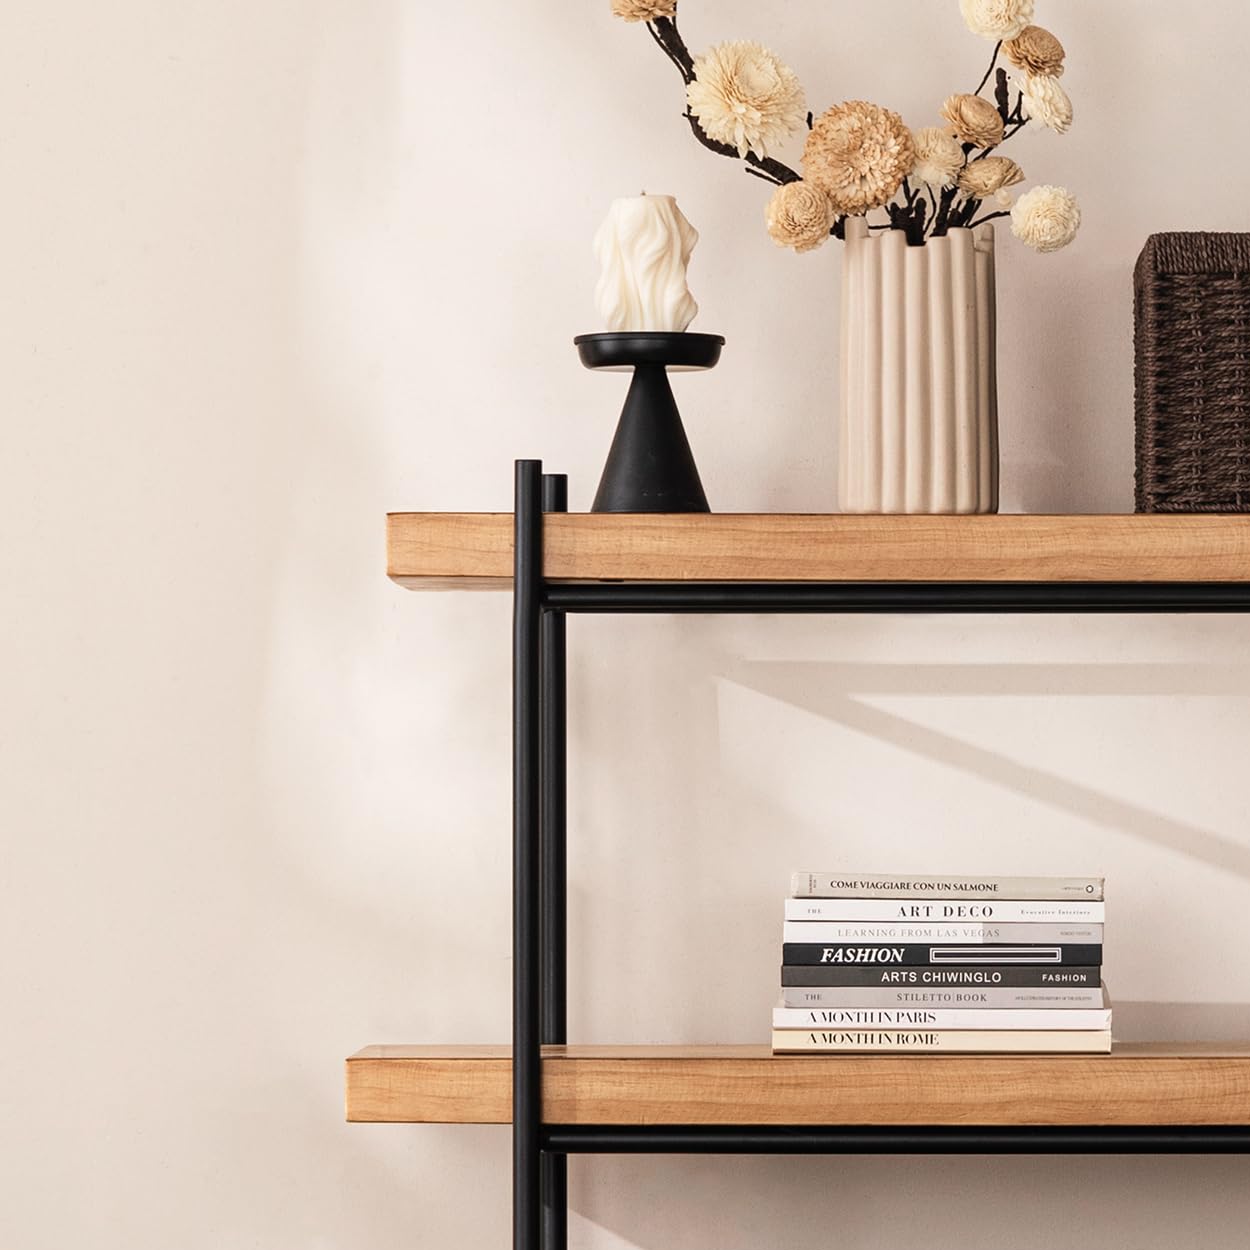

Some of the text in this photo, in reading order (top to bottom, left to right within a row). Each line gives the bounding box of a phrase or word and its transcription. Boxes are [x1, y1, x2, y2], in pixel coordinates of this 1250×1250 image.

[830, 880, 999, 892] COME VIAGGIARE CON UN SALMONE
[897, 906, 934, 917] ART
[943, 905, 994, 918] DECO
[837, 928, 1000, 937] LEARNING FROM LAS VEGAS
[820, 947, 906, 963] FASHION
[881, 971, 1088, 983] ARTS CHIWINGLO FASHION
[805, 993, 988, 1002] THE STILETTO BOOK
[807, 1011, 937, 1023] A MONTH IN PARIS
[807, 1033, 940, 1046] A MONTH IN ROME
